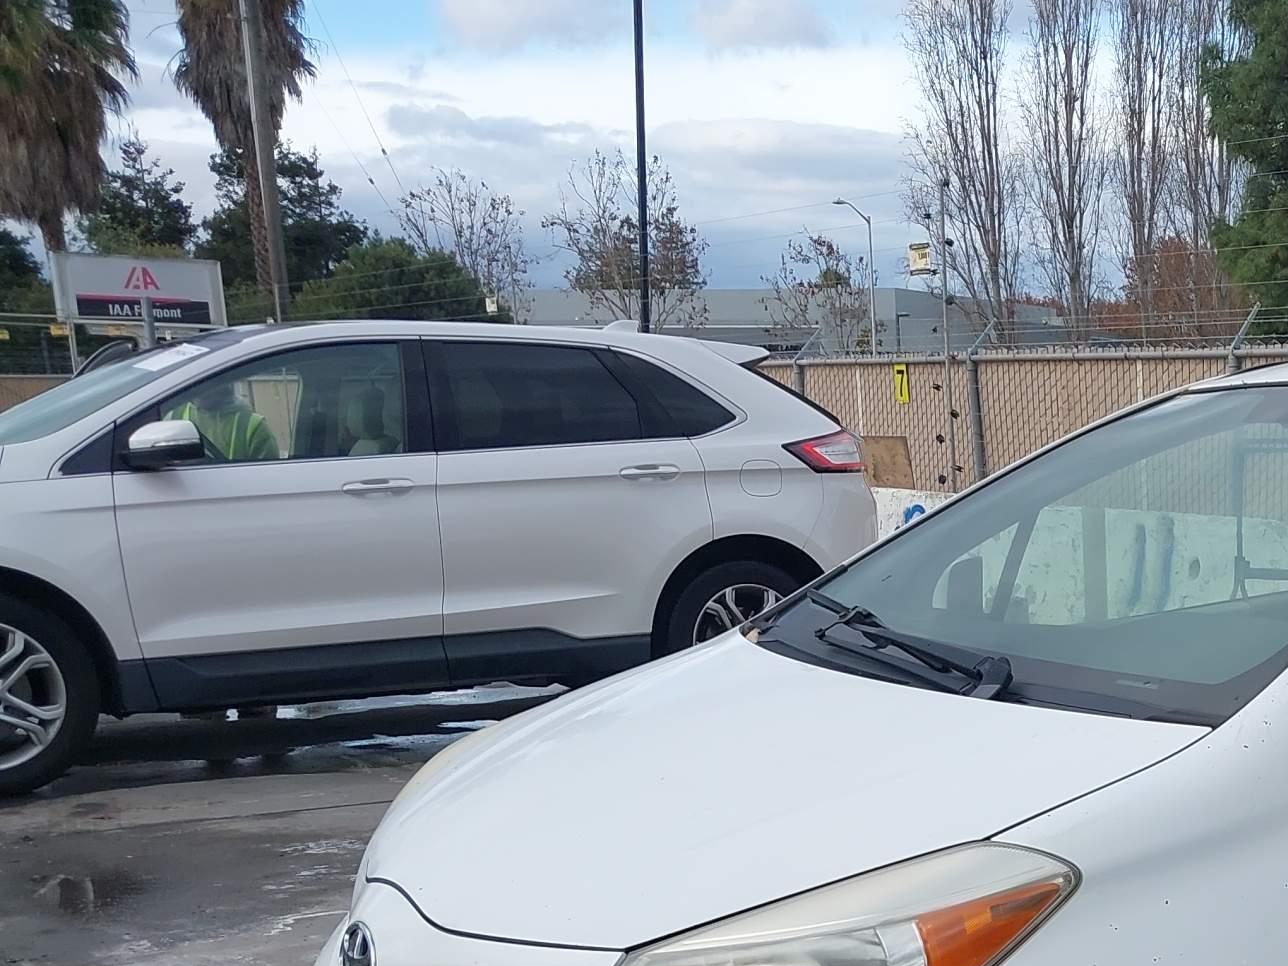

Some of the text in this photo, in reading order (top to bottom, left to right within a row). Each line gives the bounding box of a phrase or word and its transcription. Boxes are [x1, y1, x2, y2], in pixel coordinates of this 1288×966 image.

[108, 303, 182, 318] IAA Fmont
[896, 369, 905, 397] 7
